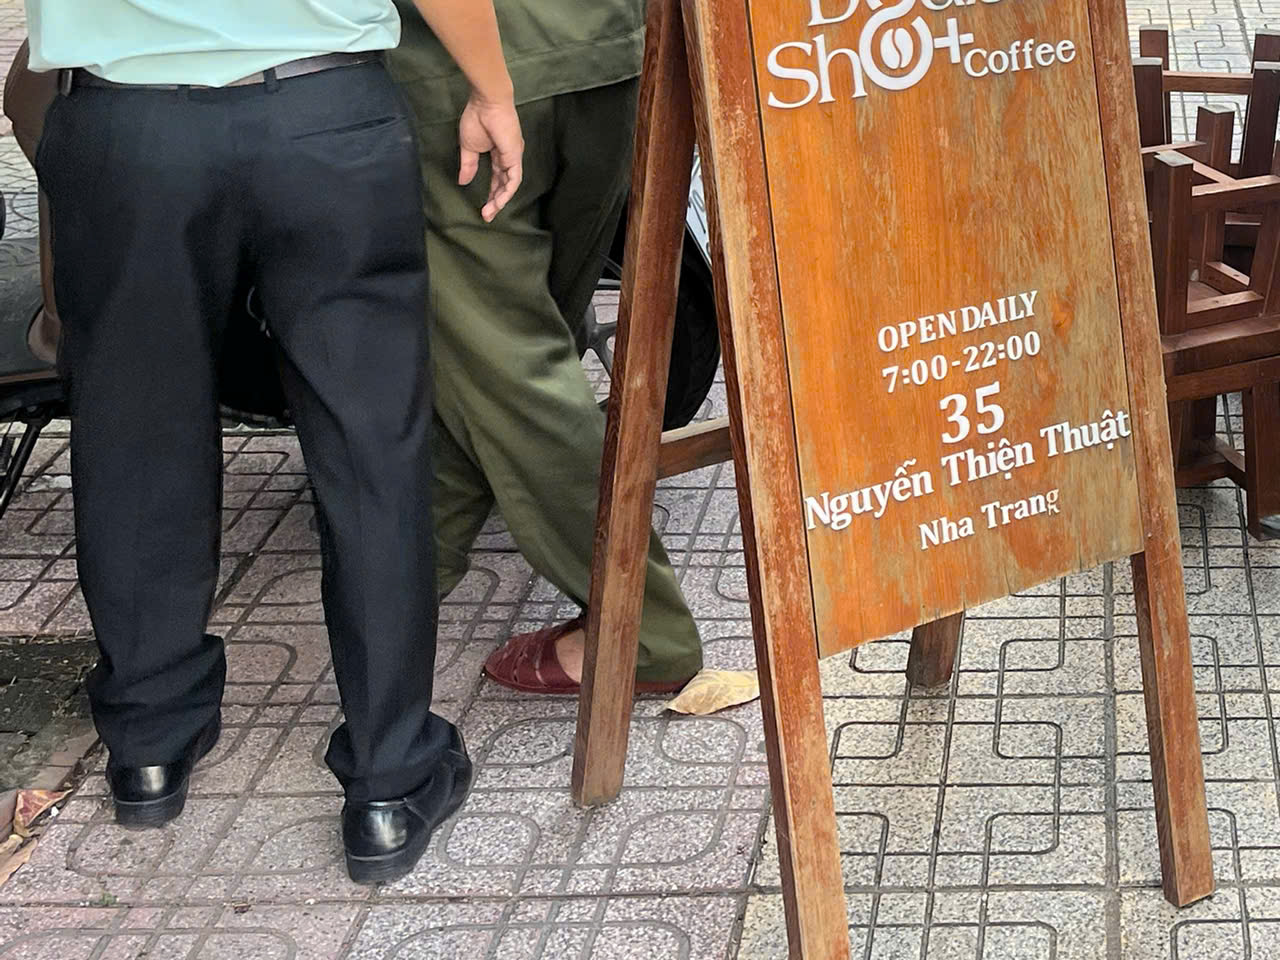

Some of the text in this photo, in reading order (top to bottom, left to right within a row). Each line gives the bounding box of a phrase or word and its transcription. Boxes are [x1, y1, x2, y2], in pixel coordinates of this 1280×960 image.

[877, 290, 1038, 353] OPEN DAILY
[939, 381, 1005, 444] 35
[804, 409, 1132, 531] Nguyễn Thiện Thuật
[918, 488, 1060, 551] Nha Trang
